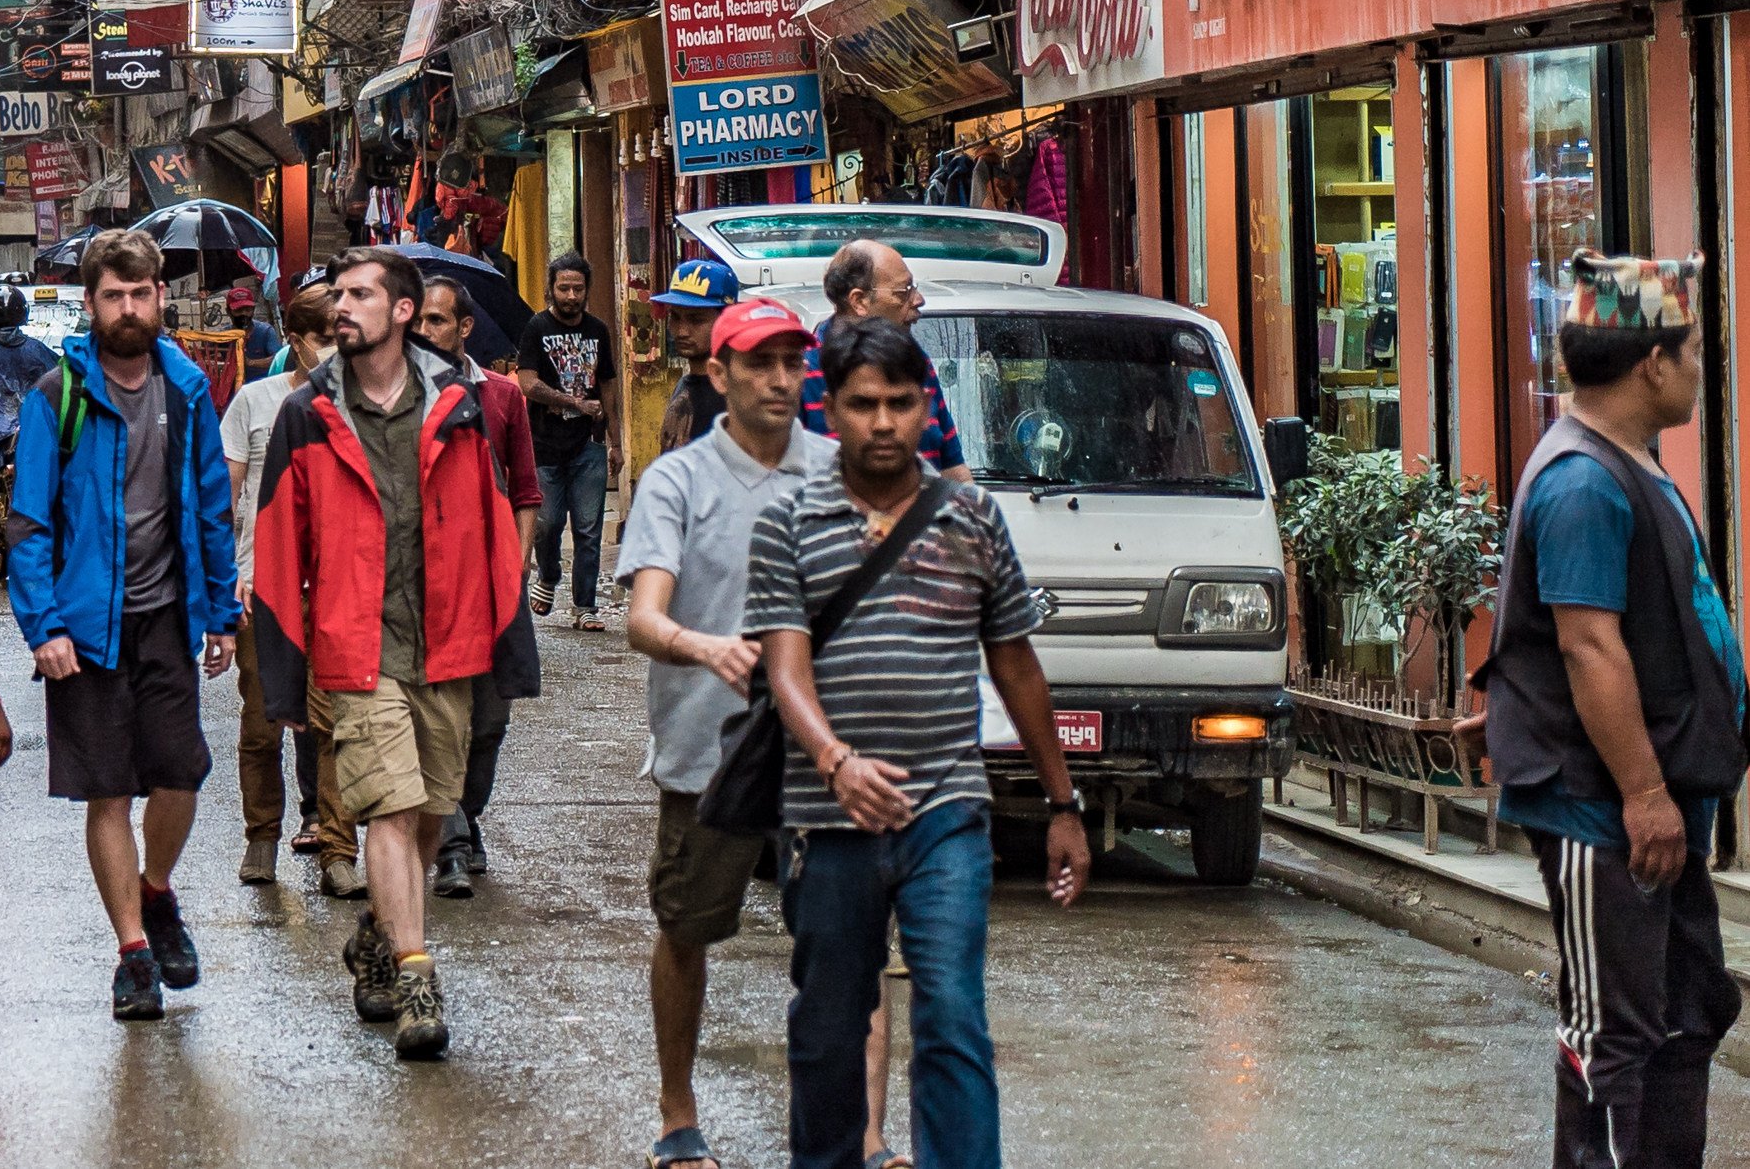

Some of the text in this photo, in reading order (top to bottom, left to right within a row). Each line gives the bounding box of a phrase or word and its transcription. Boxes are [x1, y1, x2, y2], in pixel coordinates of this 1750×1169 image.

[670, 3, 691, 21] Sim
[693, 0, 724, 21] Card,
[206, 36, 236, 47] 100m
[676, 22, 775, 48] Hookah Flavour,
[690, 52, 773, 73] TEA COFFEE
[106, 69, 161, 82] lonely planet
[698, 84, 796, 112] LORD
[680, 109, 818, 147] PHARMACY
[720, 147, 785, 165] INSIDE
